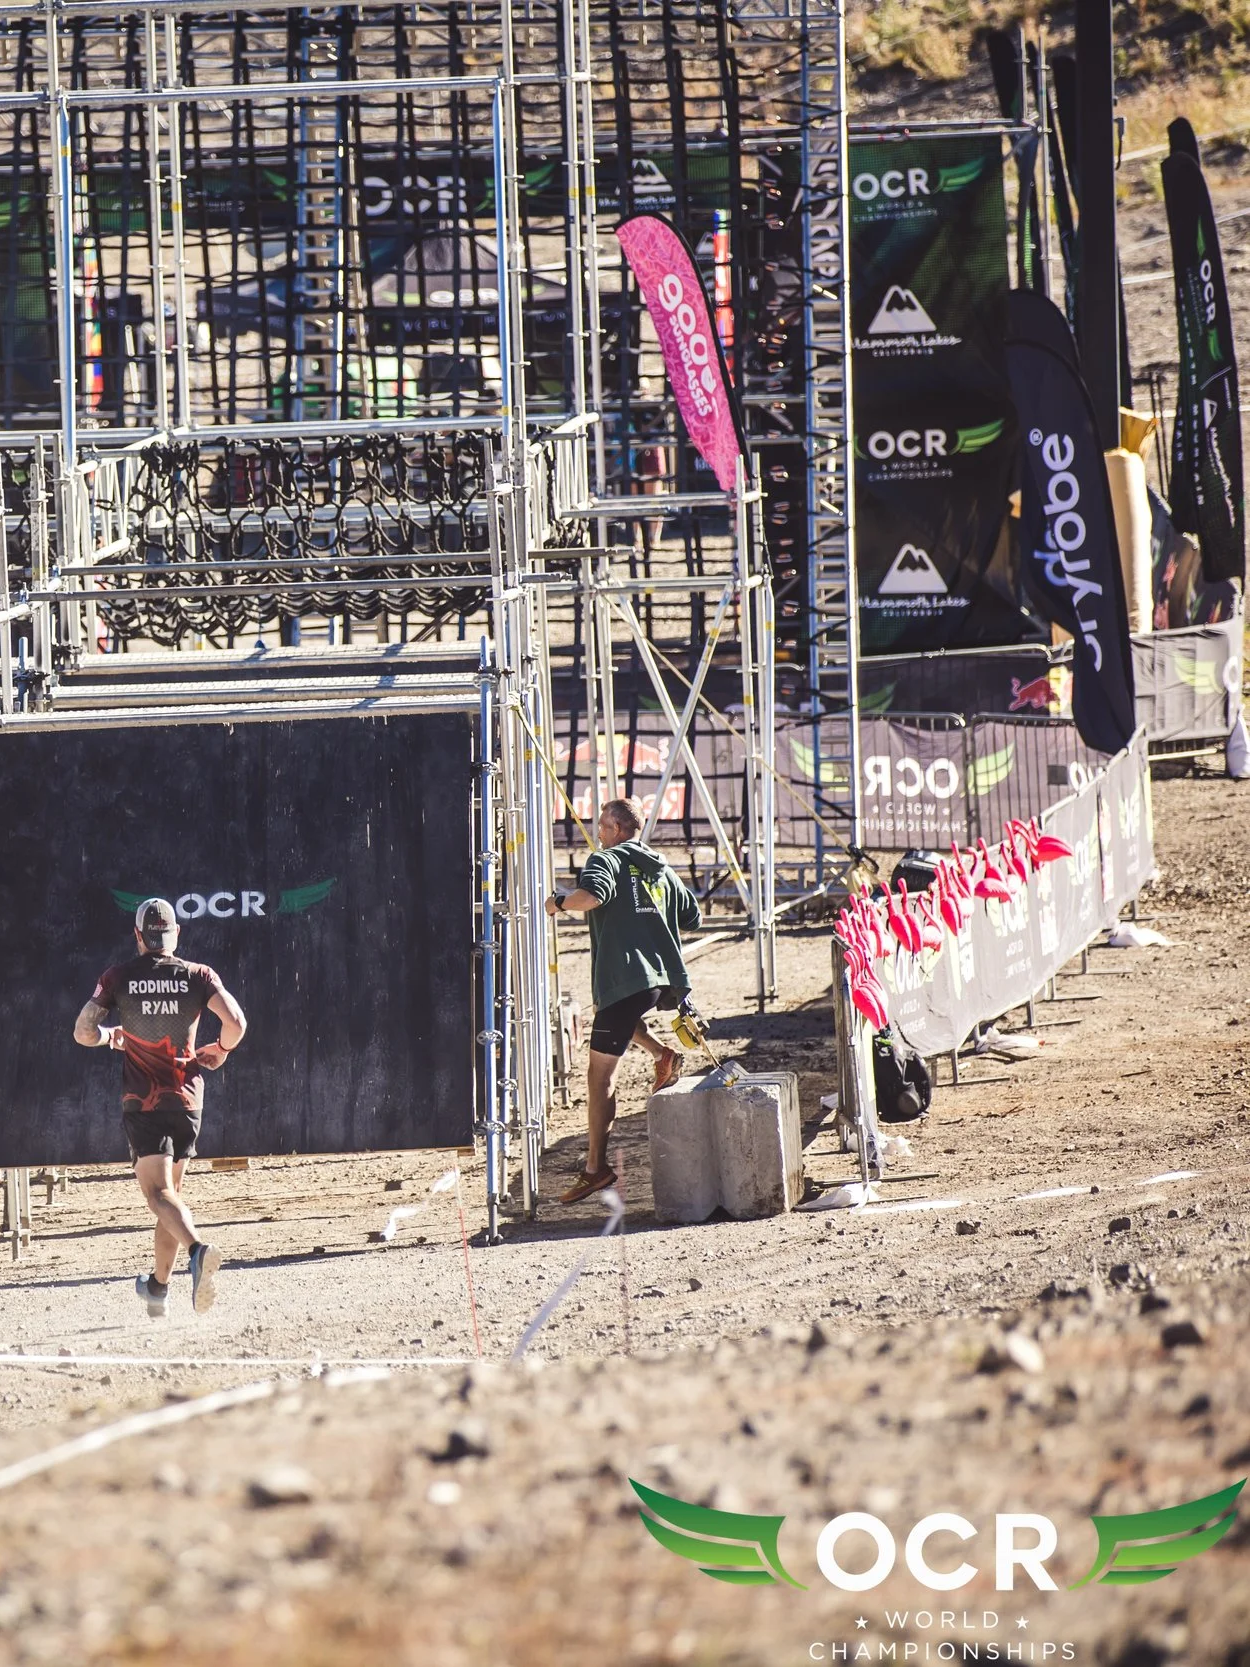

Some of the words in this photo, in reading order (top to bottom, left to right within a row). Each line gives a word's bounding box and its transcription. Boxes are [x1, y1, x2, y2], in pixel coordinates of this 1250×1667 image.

[364, 176, 467, 216] OCR
[852, 168, 931, 201] OCR
[1200, 259, 1216, 325] OCR
[669, 314, 713, 417] SUNGLASSES
[868, 428, 948, 460] OCR
[175, 890, 266, 919] OCR
[128, 979, 189, 995] RODIMUS
[141, 1000, 179, 1015] RYAN
